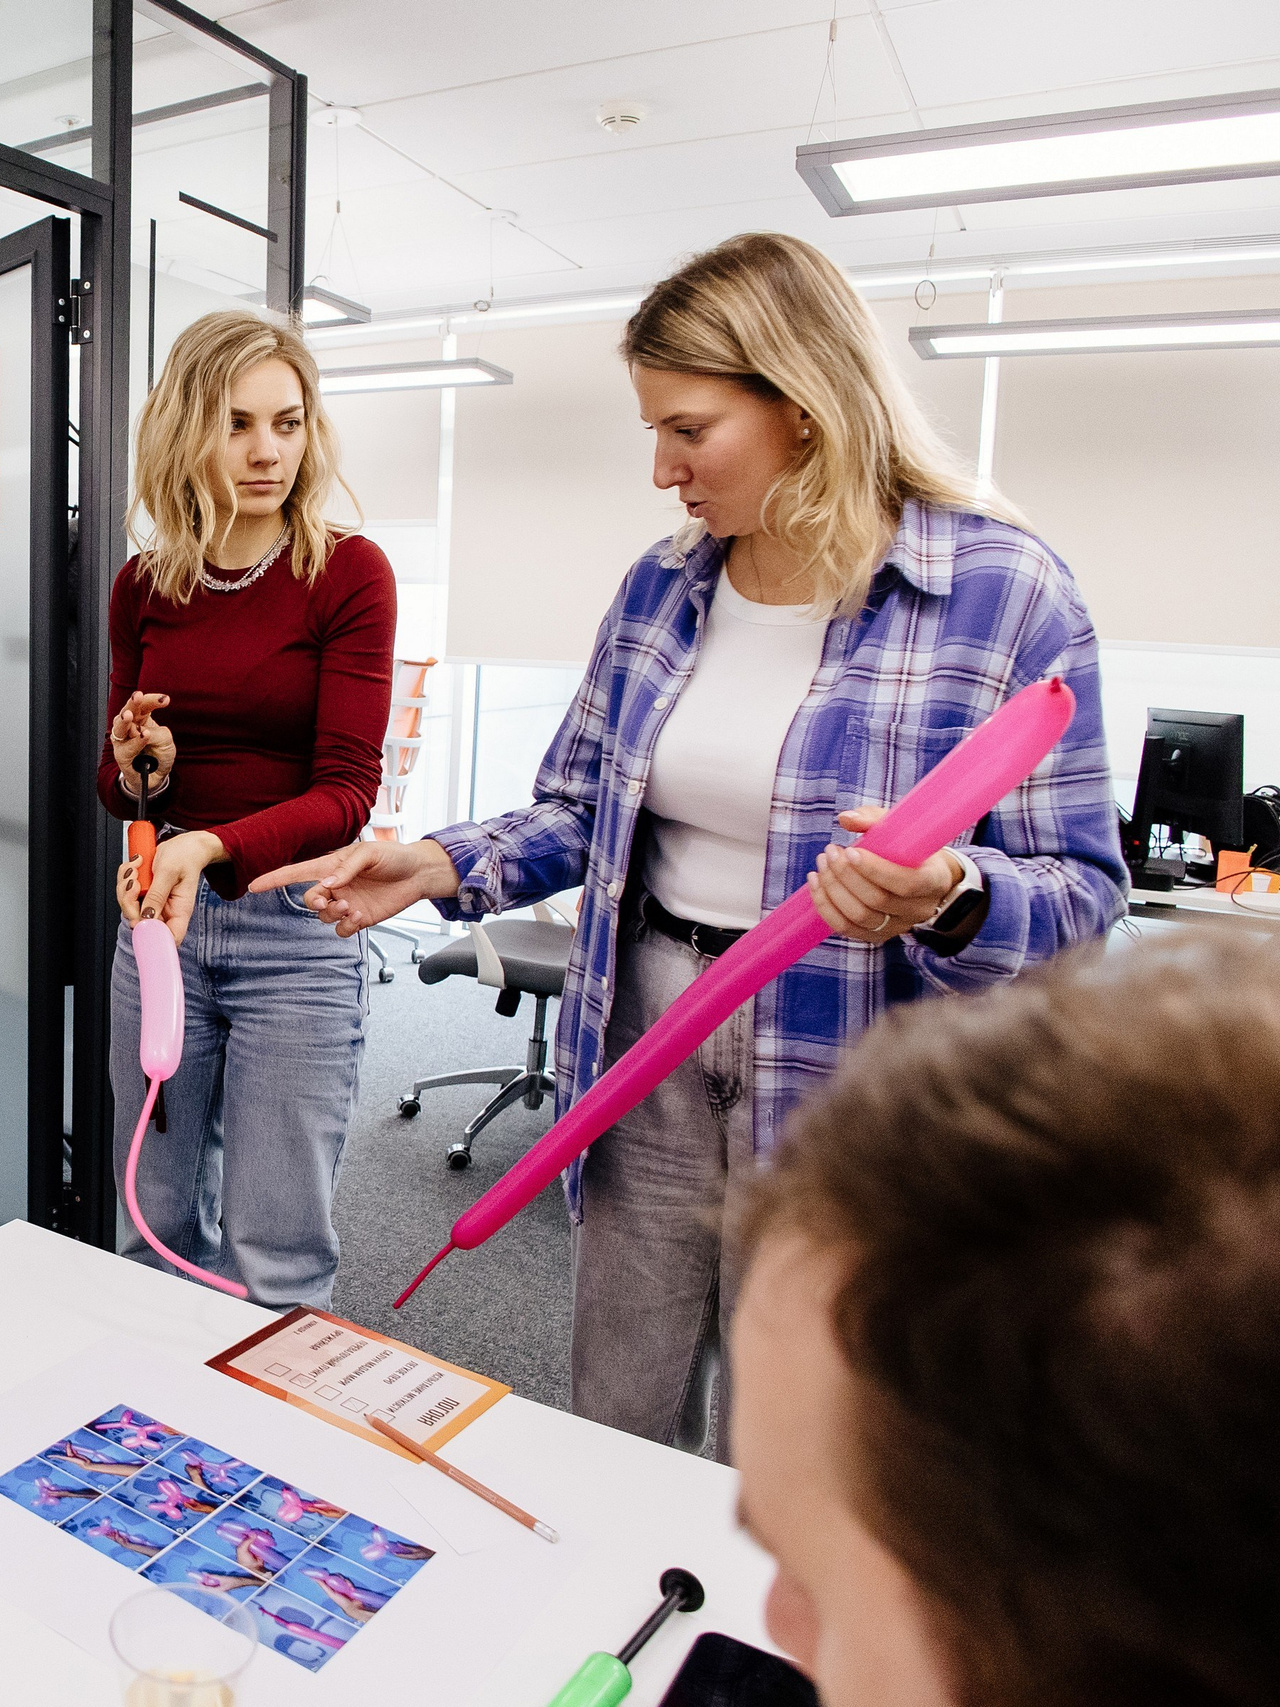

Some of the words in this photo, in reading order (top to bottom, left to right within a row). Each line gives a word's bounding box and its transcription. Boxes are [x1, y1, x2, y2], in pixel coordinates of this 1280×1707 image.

[337, 1369, 357, 1386] МАРИ
[355, 1356, 377, 1377] МАДАМ
[386, 1389, 417, 1413] МЕТКОСТИ
[417, 1396, 461, 1427] ПОГОНЯ
